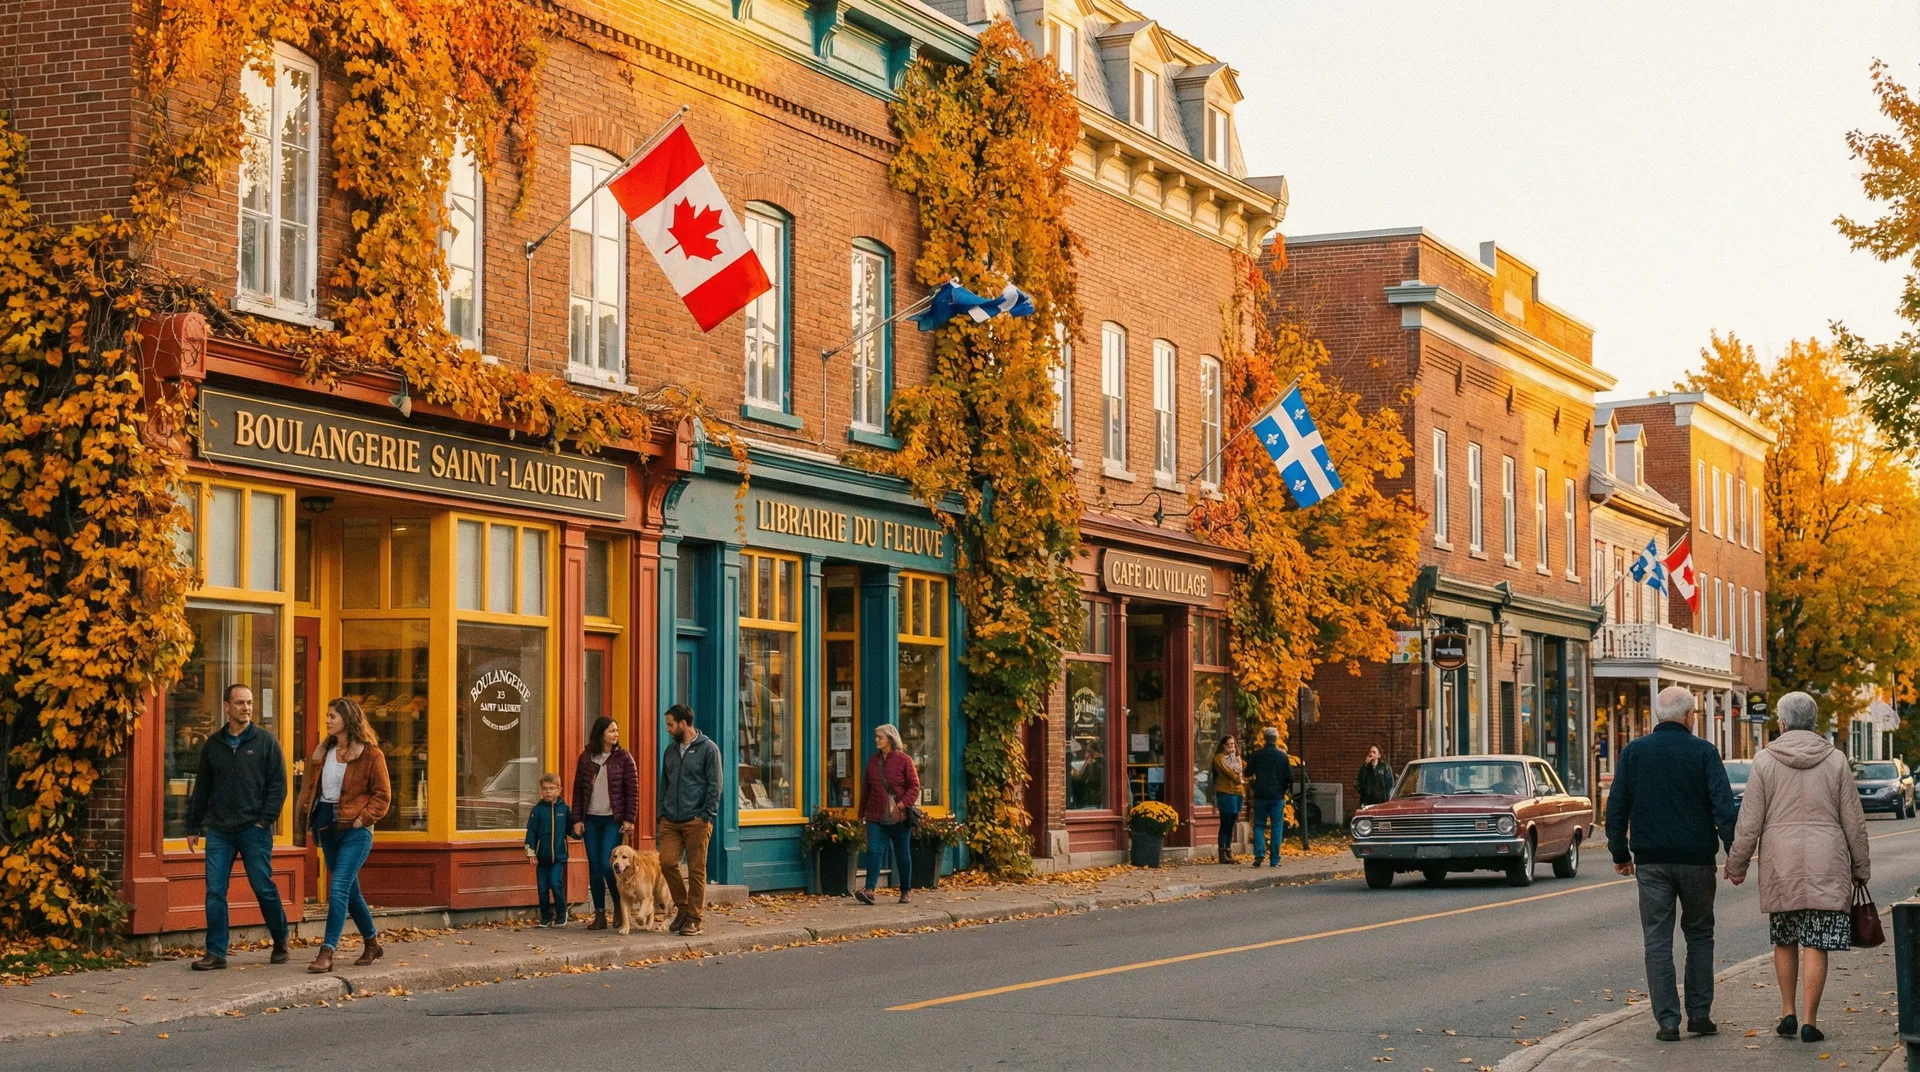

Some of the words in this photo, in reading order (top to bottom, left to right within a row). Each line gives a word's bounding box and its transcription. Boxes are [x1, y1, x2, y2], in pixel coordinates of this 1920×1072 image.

[236, 410, 421, 473] BOULANGERIE
[431, 444, 605, 502] SAINT-LAURENT
[757, 499, 848, 543] LIBRAIRIE
[853, 516, 878, 547] DU
[883, 521, 944, 559] FLEUVE
[1112, 558, 1142, 588] CAFÉ
[1145, 566, 1161, 590] DU
[1163, 569, 1208, 598] VILLAGE
